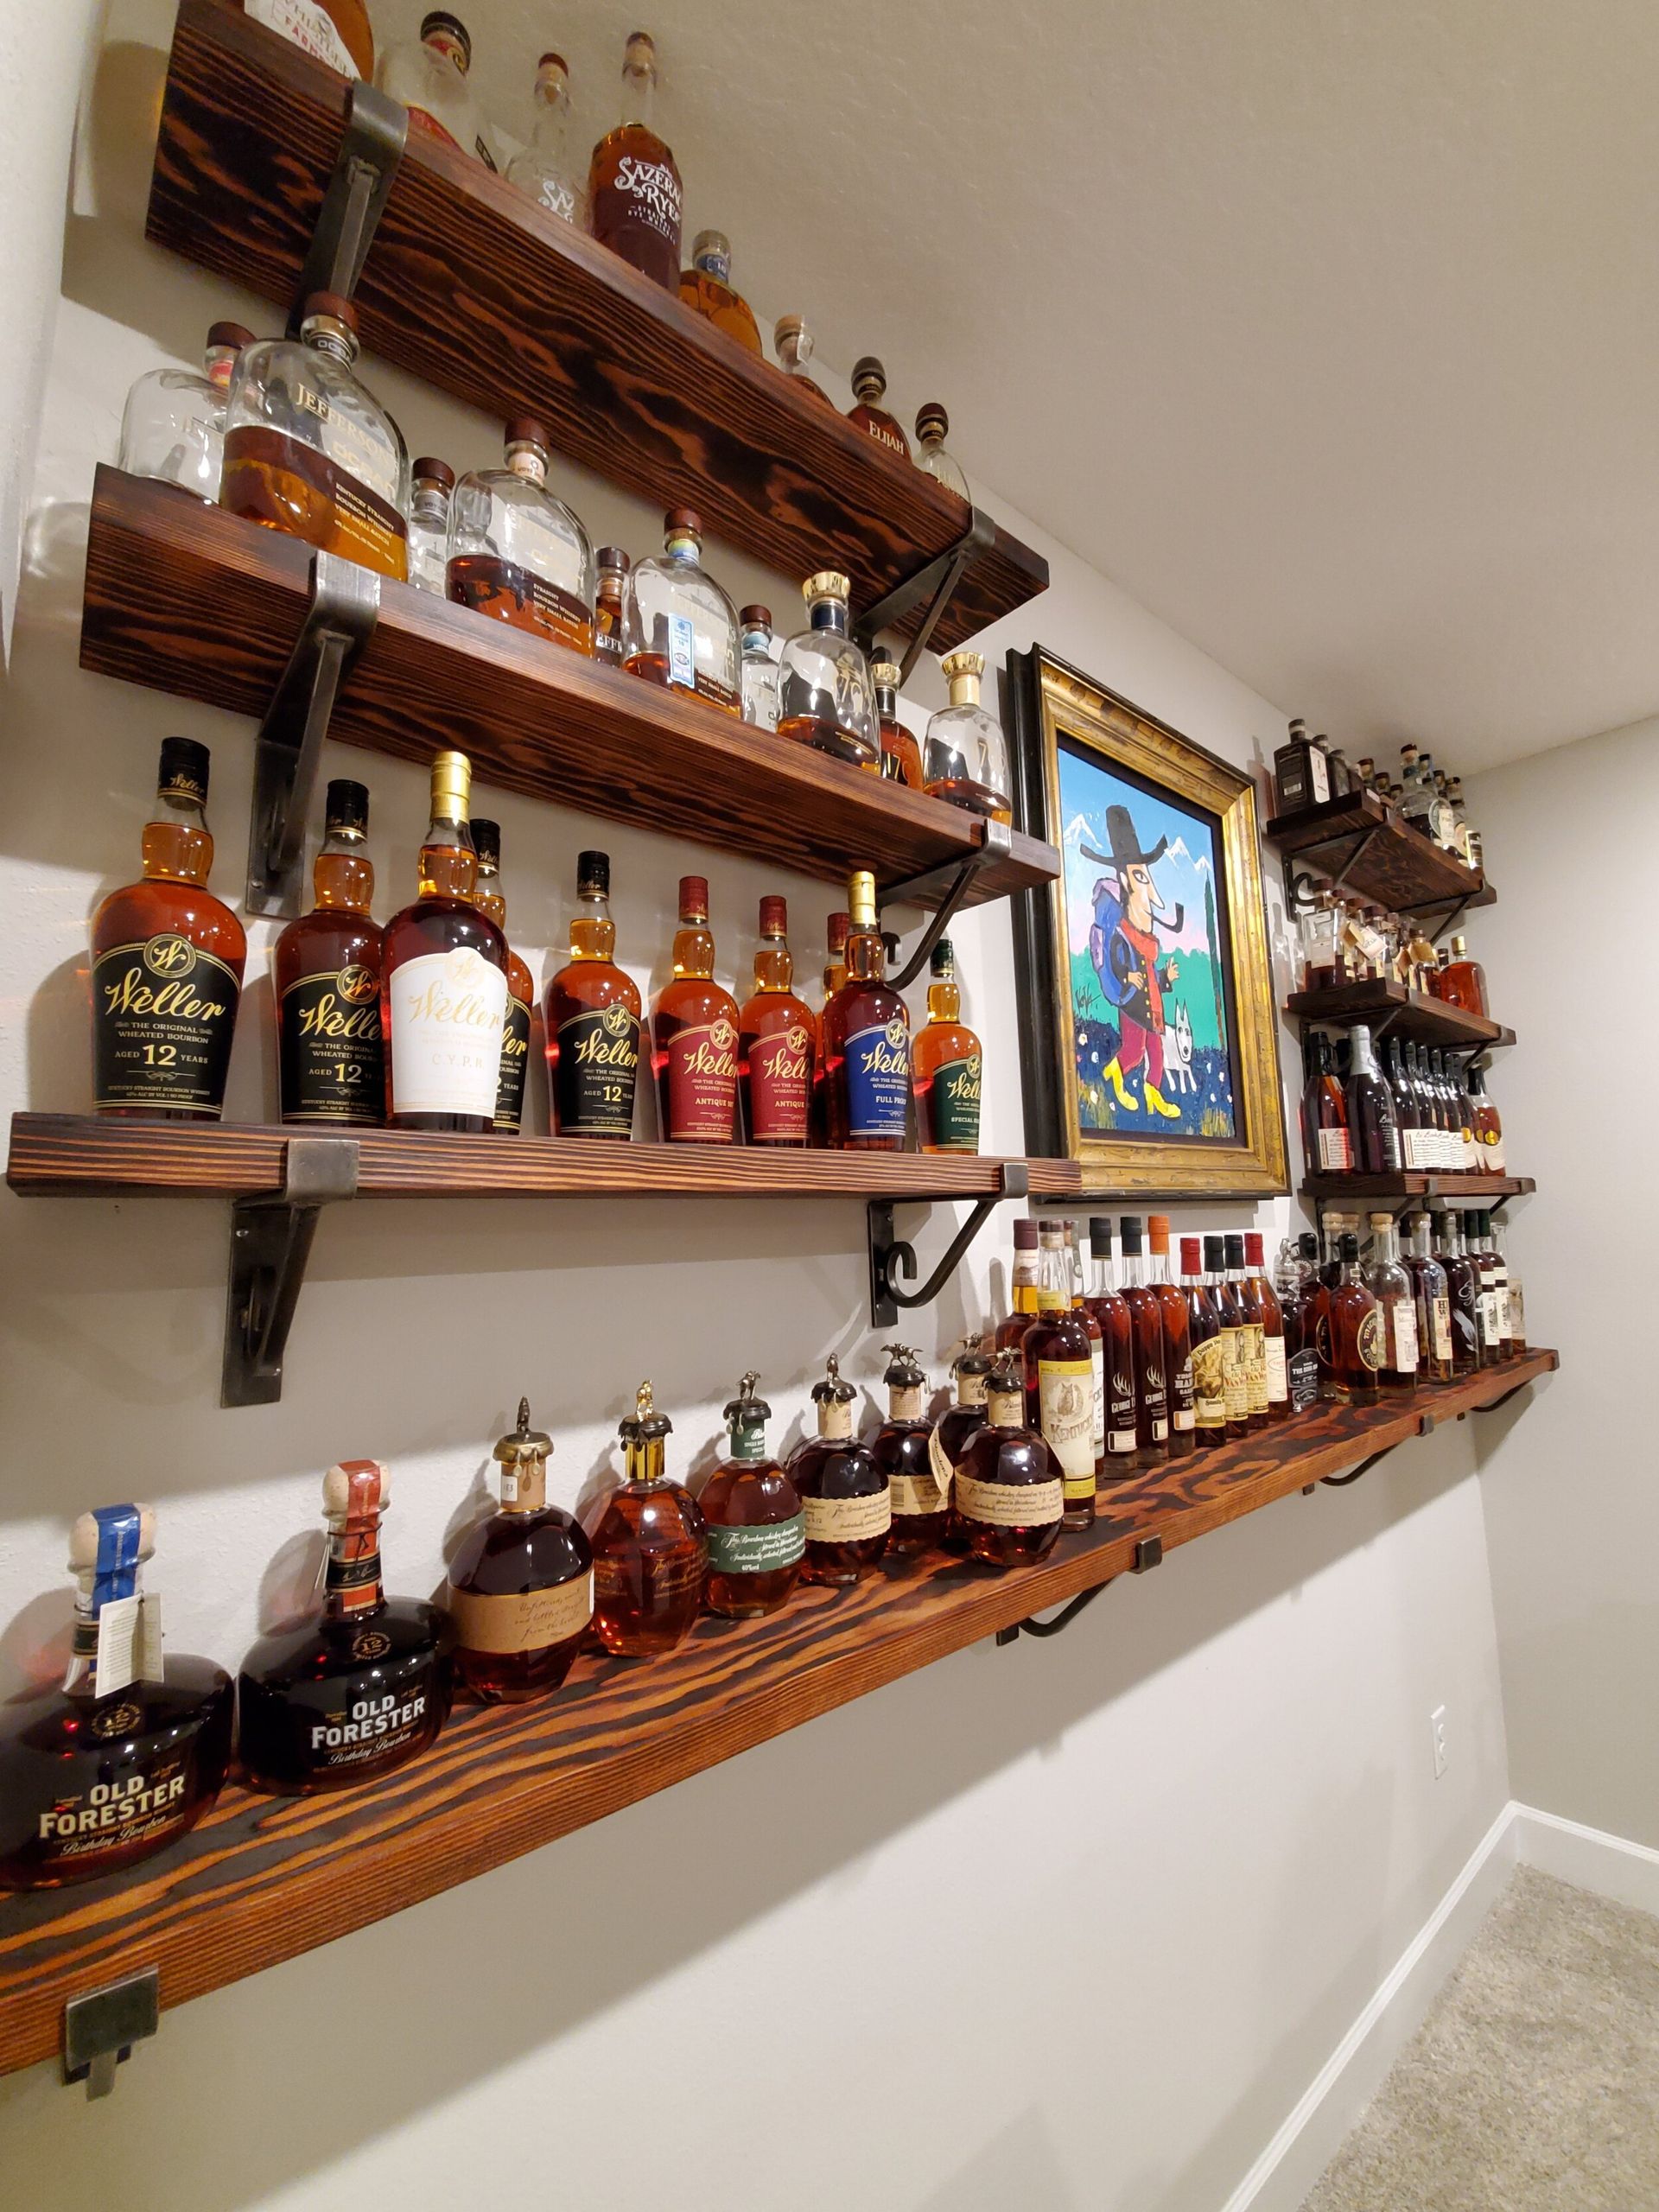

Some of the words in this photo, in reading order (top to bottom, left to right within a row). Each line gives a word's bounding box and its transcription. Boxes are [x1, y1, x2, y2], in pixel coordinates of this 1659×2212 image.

[868, 420, 905, 455] ELIJAH
[335, 493, 366, 518] BOURBON
[335, 483, 366, 509] KENTUCKY
[366, 505, 394, 531] STRAIGHT
[334, 503, 351, 518] VERY
[351, 514, 370, 531] SMALL
[370, 529, 390, 546] BATCH
[533, 583, 559, 601] STRAIGHT
[533, 591, 559, 609] BOURBON
[533, 600, 546, 610] VERY
[546, 607, 563, 620] SMALL
[170, 773, 206, 795] Weller
[105, 967, 226, 1021] Weller
[408, 980, 501, 1030] Weller
[152, 1023, 198, 1034] ORIGINAL
[299, 994, 381, 1041] Welle
[167, 1033, 209, 1044] BOURBON
[343, 1044, 374, 1054] ORIGINA
[143, 1044, 177, 1066] 12
[180, 1054, 208, 1065] YEARS
[312, 1050, 353, 1058] WHEATED
[762, 1048, 809, 1080] Well
[334, 1063, 362, 1084] 12
[499, 1066, 519, 1076] OURBON
[603, 1085, 622, 1103] 12
[946, 1072, 981, 1100] Well
[695, 1097, 727, 1108] ANTIQUE
[774, 1100, 804, 1109] ANTIQUE
[353, 1694, 396, 1720] OLD
[311, 1696, 426, 1750] FORESTER
[327, 1746, 372, 1765] Birthday
[373, 1731, 412, 1754] Bourbon
[90, 1775, 145, 1806] OLD
[39, 1775, 185, 1840] FORESTER
[60, 1834, 115, 1858] Birthday
[119, 1815, 167, 1840] Bourbon
